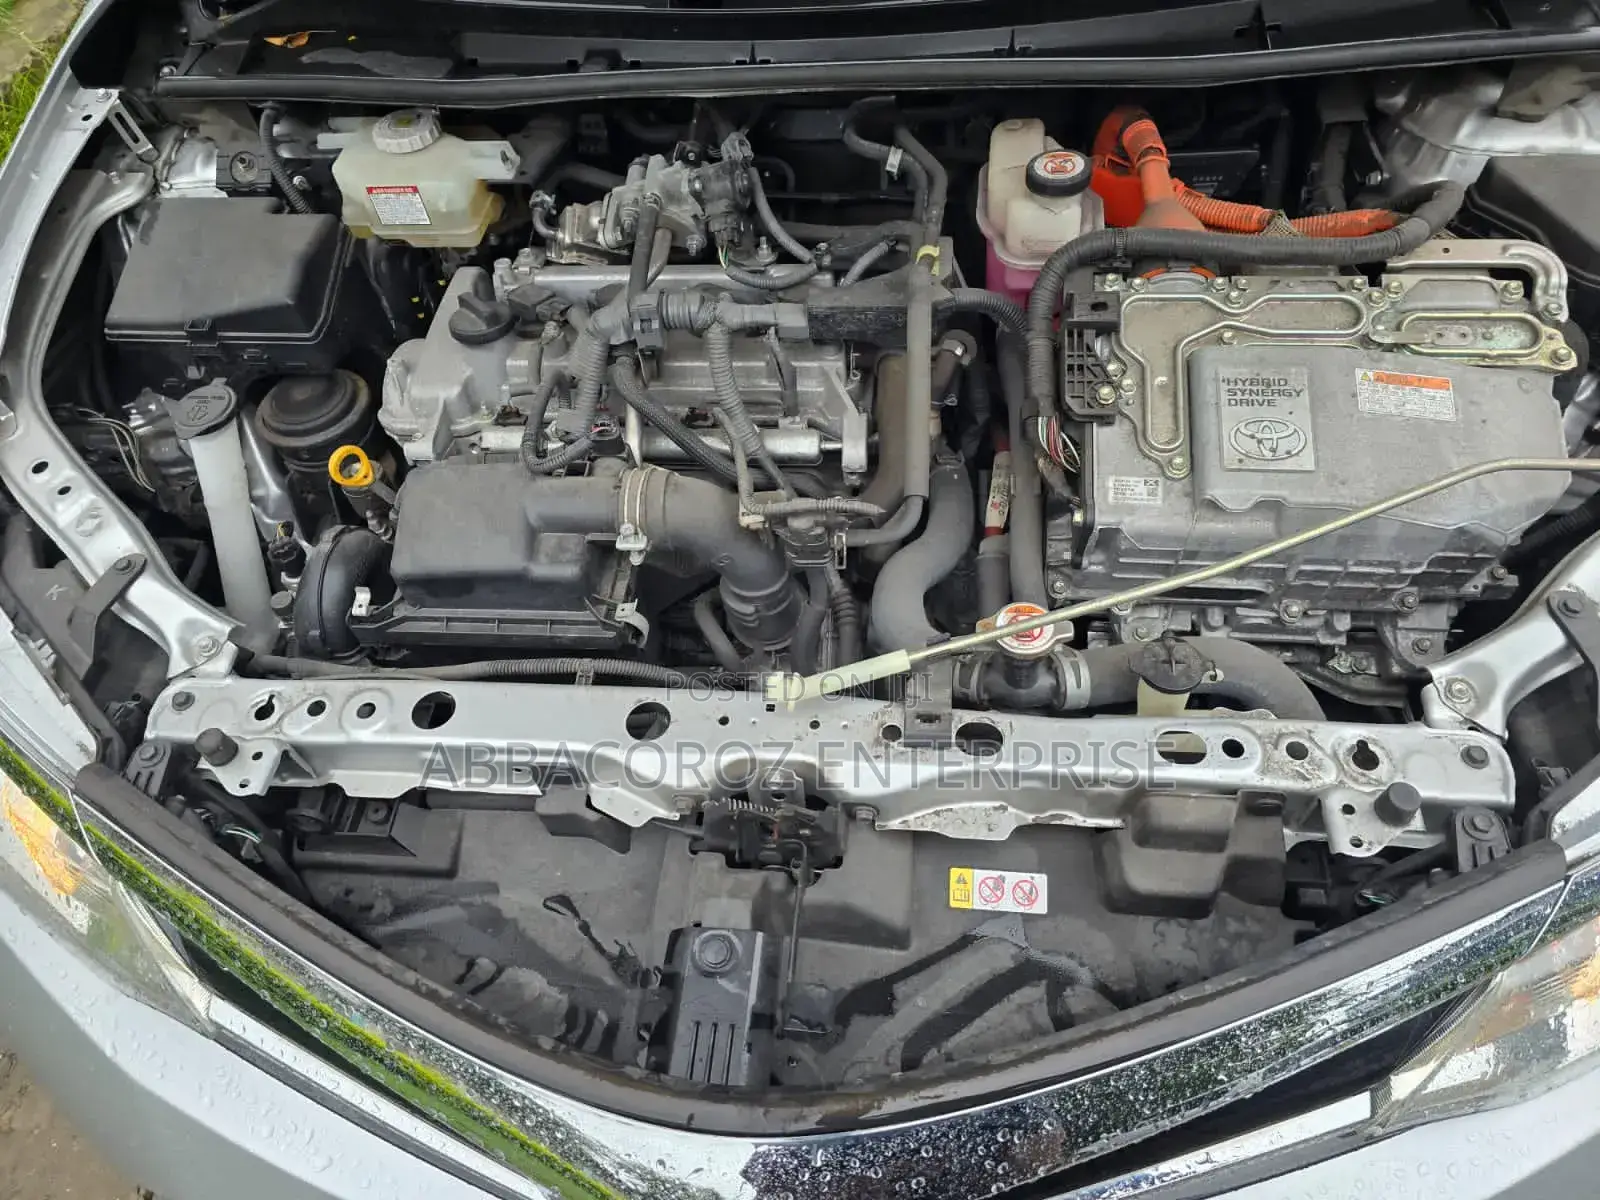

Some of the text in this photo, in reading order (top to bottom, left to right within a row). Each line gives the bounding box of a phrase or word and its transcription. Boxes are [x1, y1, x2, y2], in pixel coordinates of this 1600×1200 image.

[1226, 378, 1288, 387] HYBRID
[1227, 388, 1304, 397] SYNERGY
[1227, 398, 1278, 407] DRIVE
